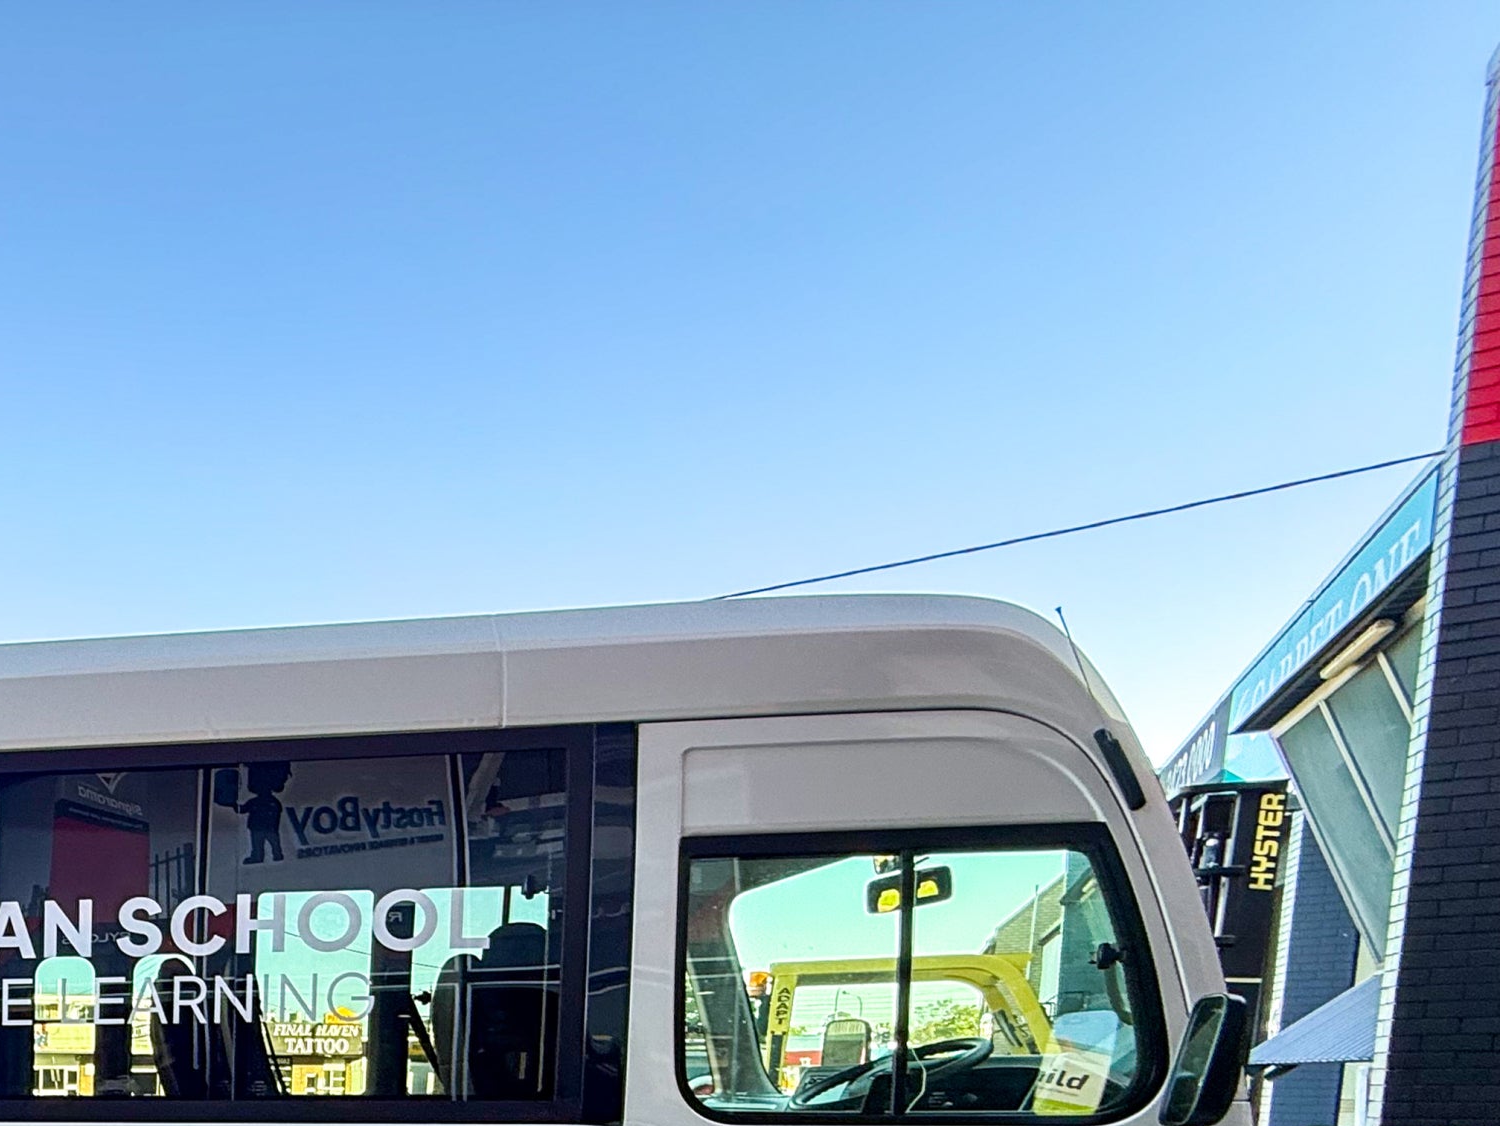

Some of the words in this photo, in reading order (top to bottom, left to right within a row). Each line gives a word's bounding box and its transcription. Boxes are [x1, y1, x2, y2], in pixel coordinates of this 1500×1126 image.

[1249, 793, 1285, 890] HYSTER
[117, 889, 490, 957] SCHOOL
[59, 972, 375, 1026] LEARNING
[775, 988, 792, 1025] ADAPT
[273, 1024, 312, 1037] FINAL
[315, 1024, 360, 1037] HAVEN
[284, 1038, 350, 1054] TATTOO
